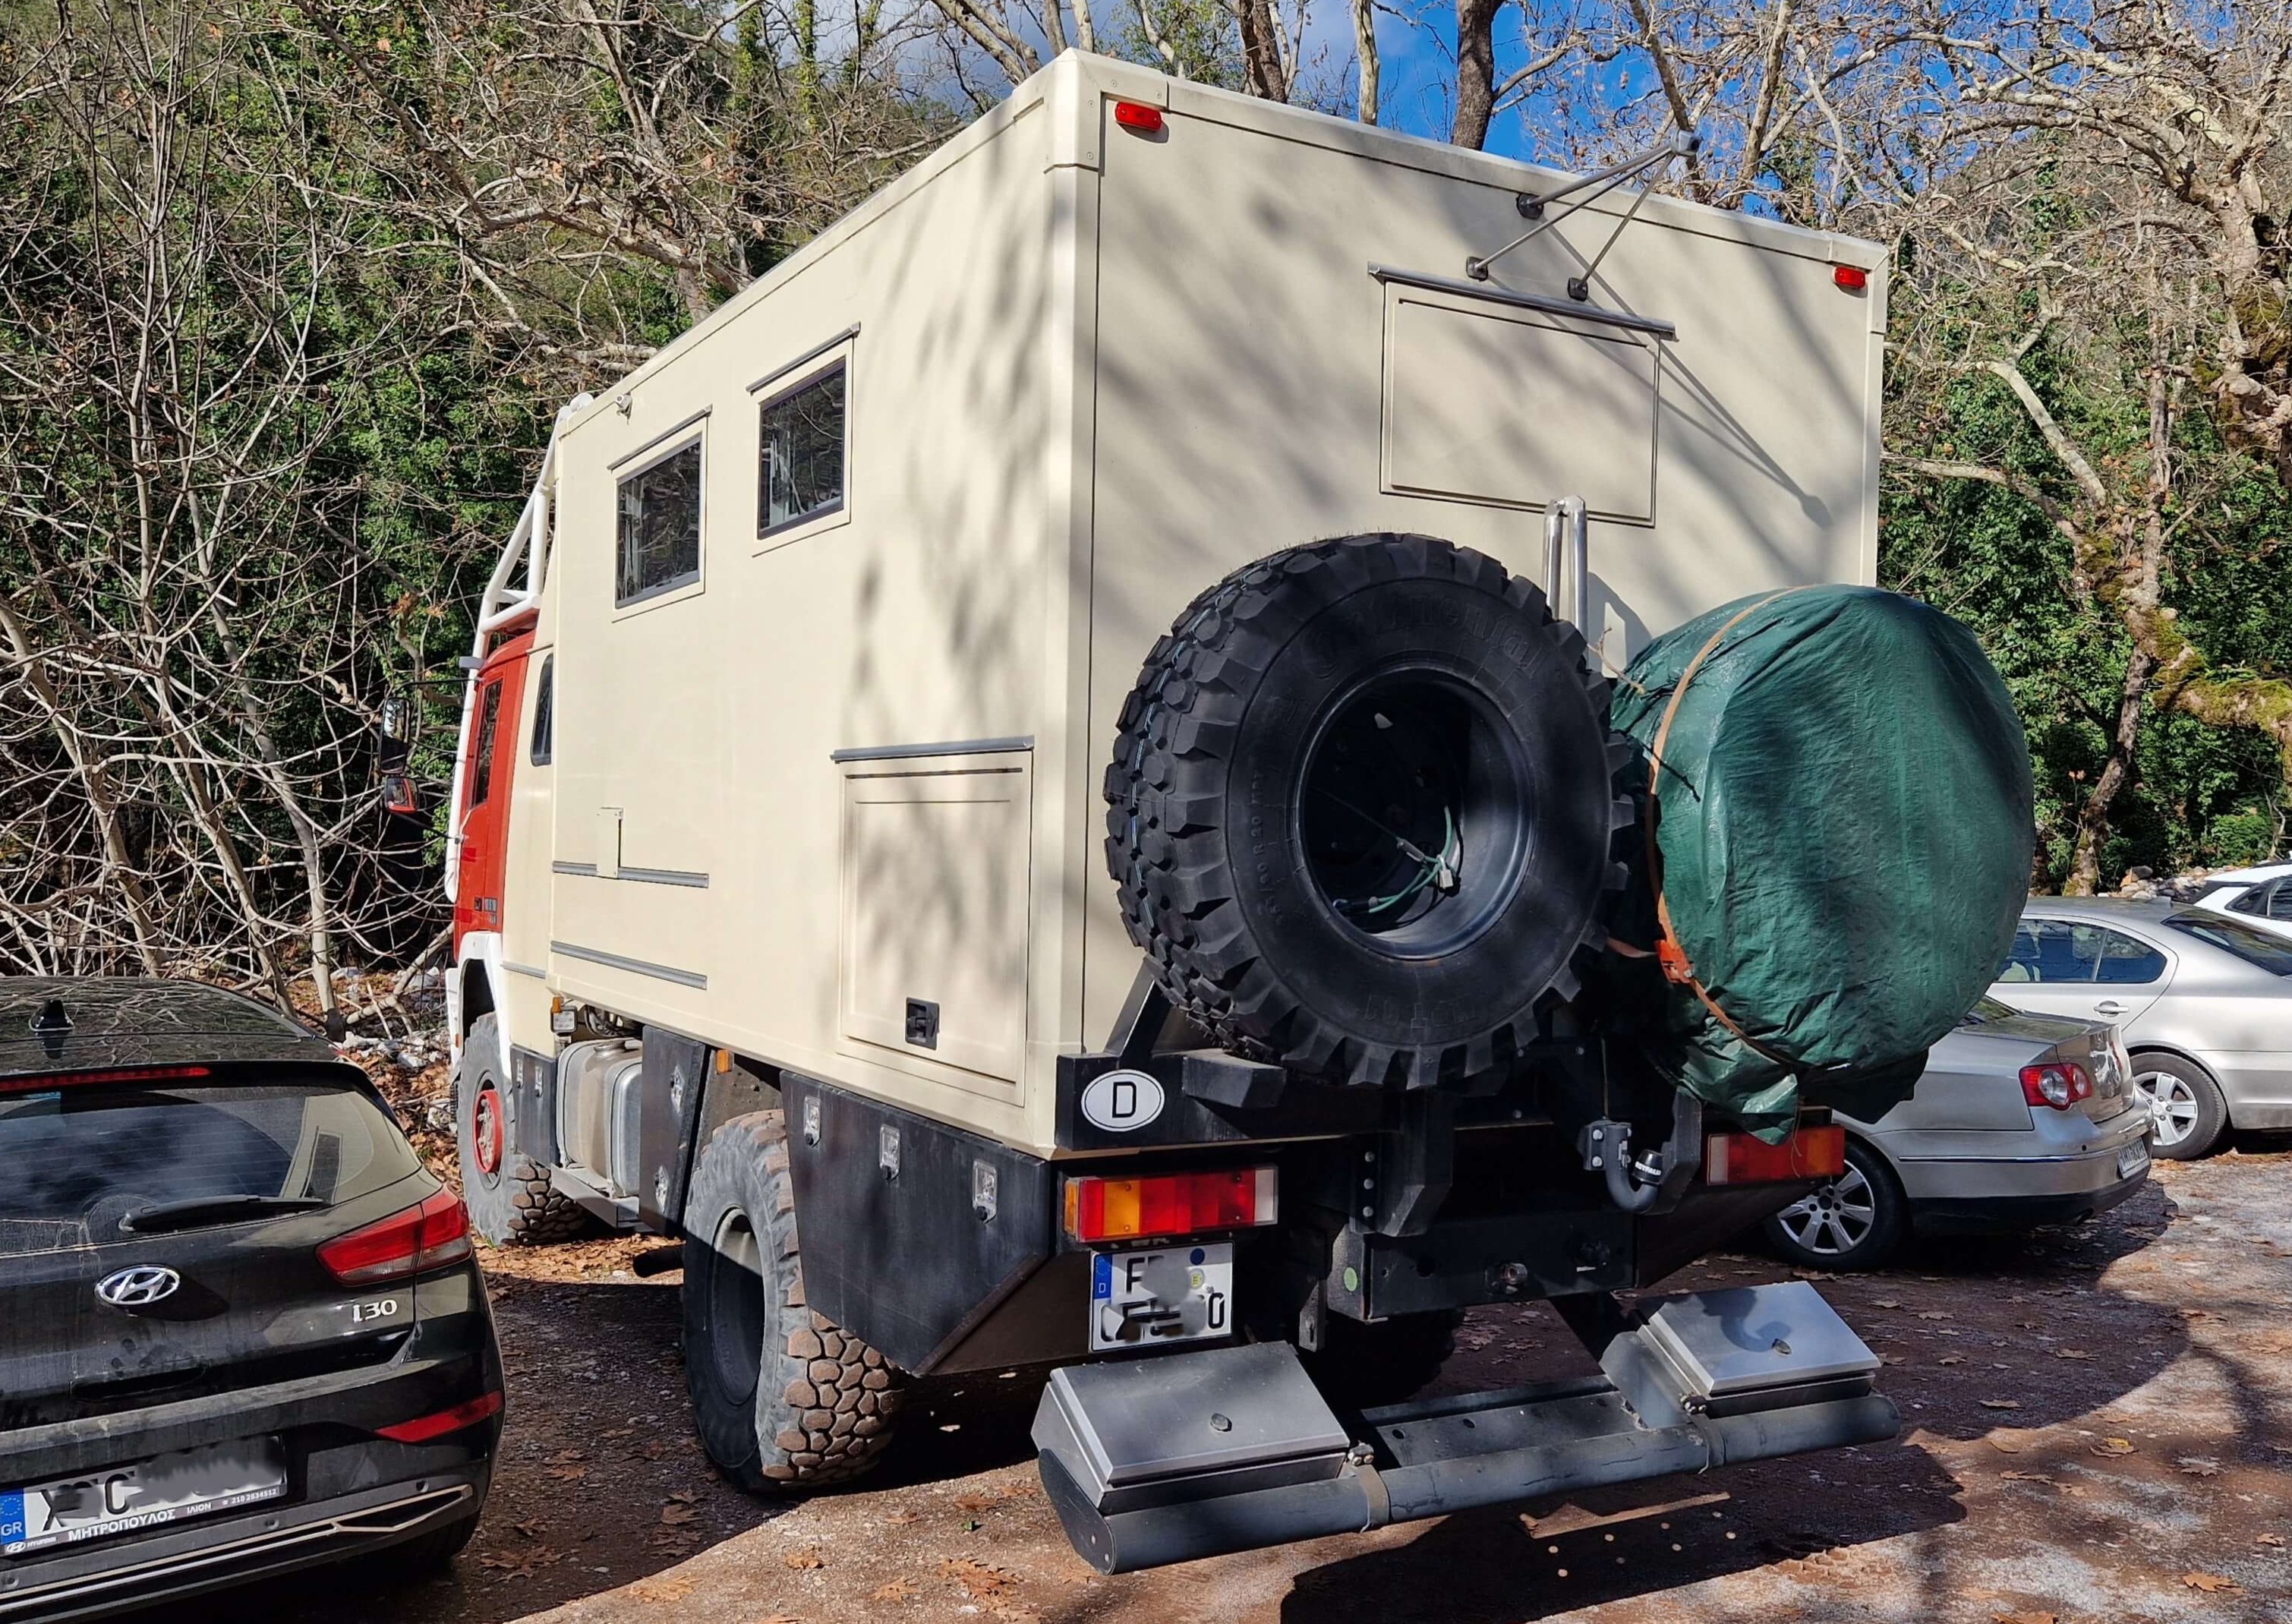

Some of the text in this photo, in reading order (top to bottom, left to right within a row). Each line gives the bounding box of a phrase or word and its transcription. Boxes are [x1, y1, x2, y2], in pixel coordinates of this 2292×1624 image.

[1112, 1081, 1137, 1118] D
[1099, 1282, 1106, 1294] D
[231, 1493, 245, 1504] 210
[1, 1521, 23, 1537] GR
[68, 1509, 176, 1541] ΜΗΤΡΟΠΟΥΛΟΣ
